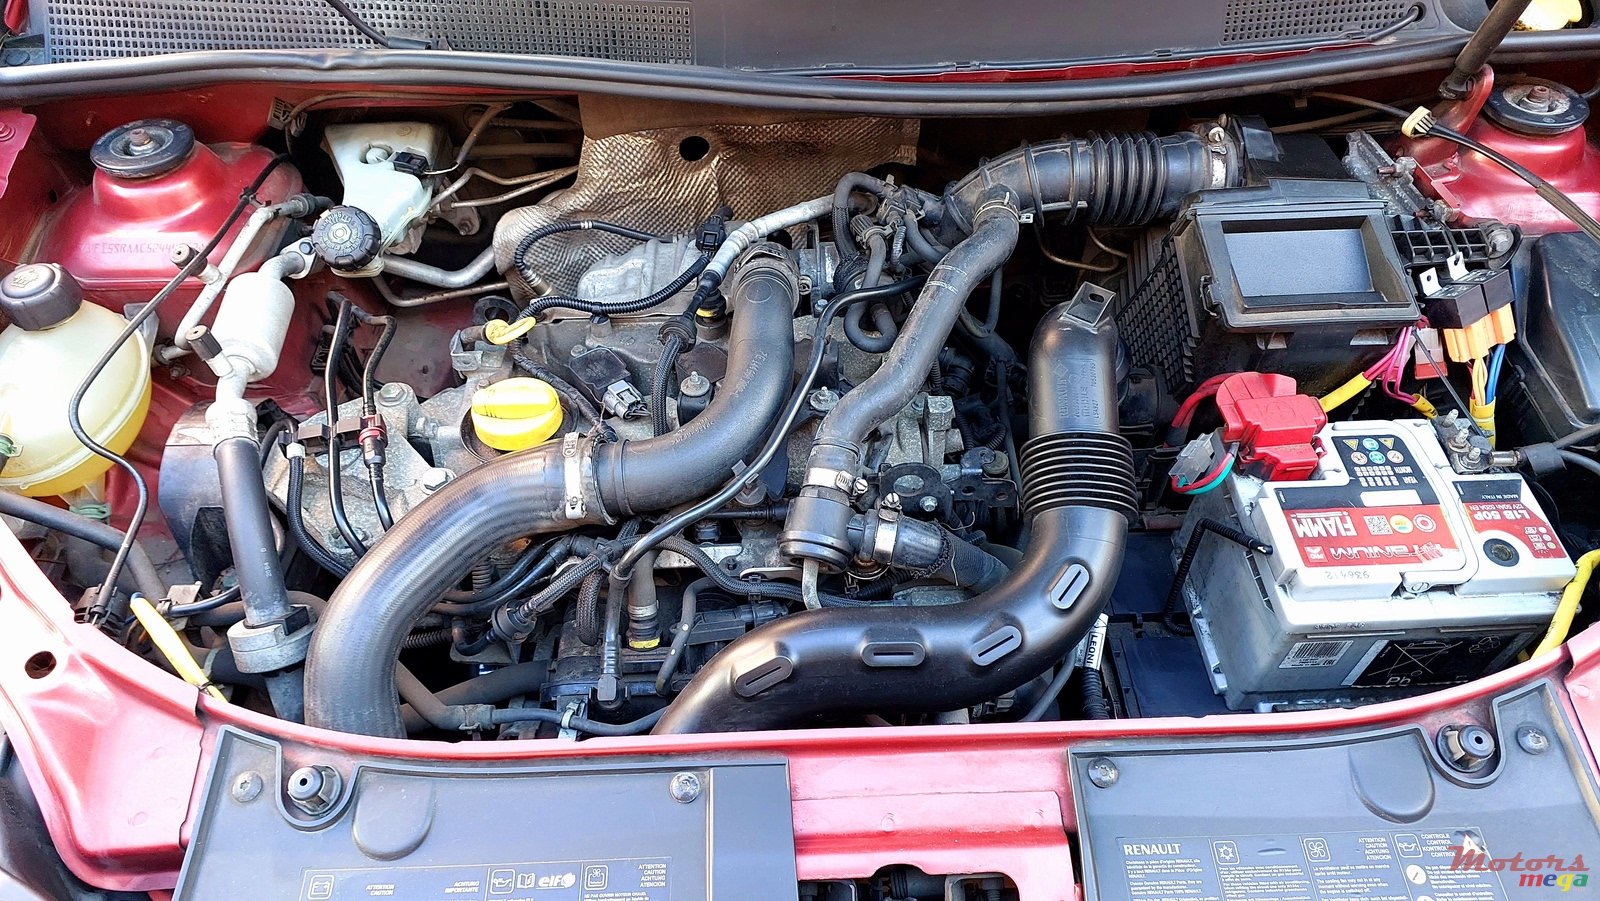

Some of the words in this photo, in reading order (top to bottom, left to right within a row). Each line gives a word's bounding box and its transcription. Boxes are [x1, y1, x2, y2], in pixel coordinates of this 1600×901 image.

[1403, 476, 1418, 484] YEAR
[1474, 511, 1500, 520] 50P
[1502, 510, 1530, 520] L1B
[1292, 516, 1358, 538] FIAMM
[1330, 543, 1441, 560] TANIUM
[1087, 634, 1098, 664] LEONI
[1386, 676, 1411, 687] Pb
[1123, 843, 1181, 856] RENAULT
[538, 874, 564, 888] elf
